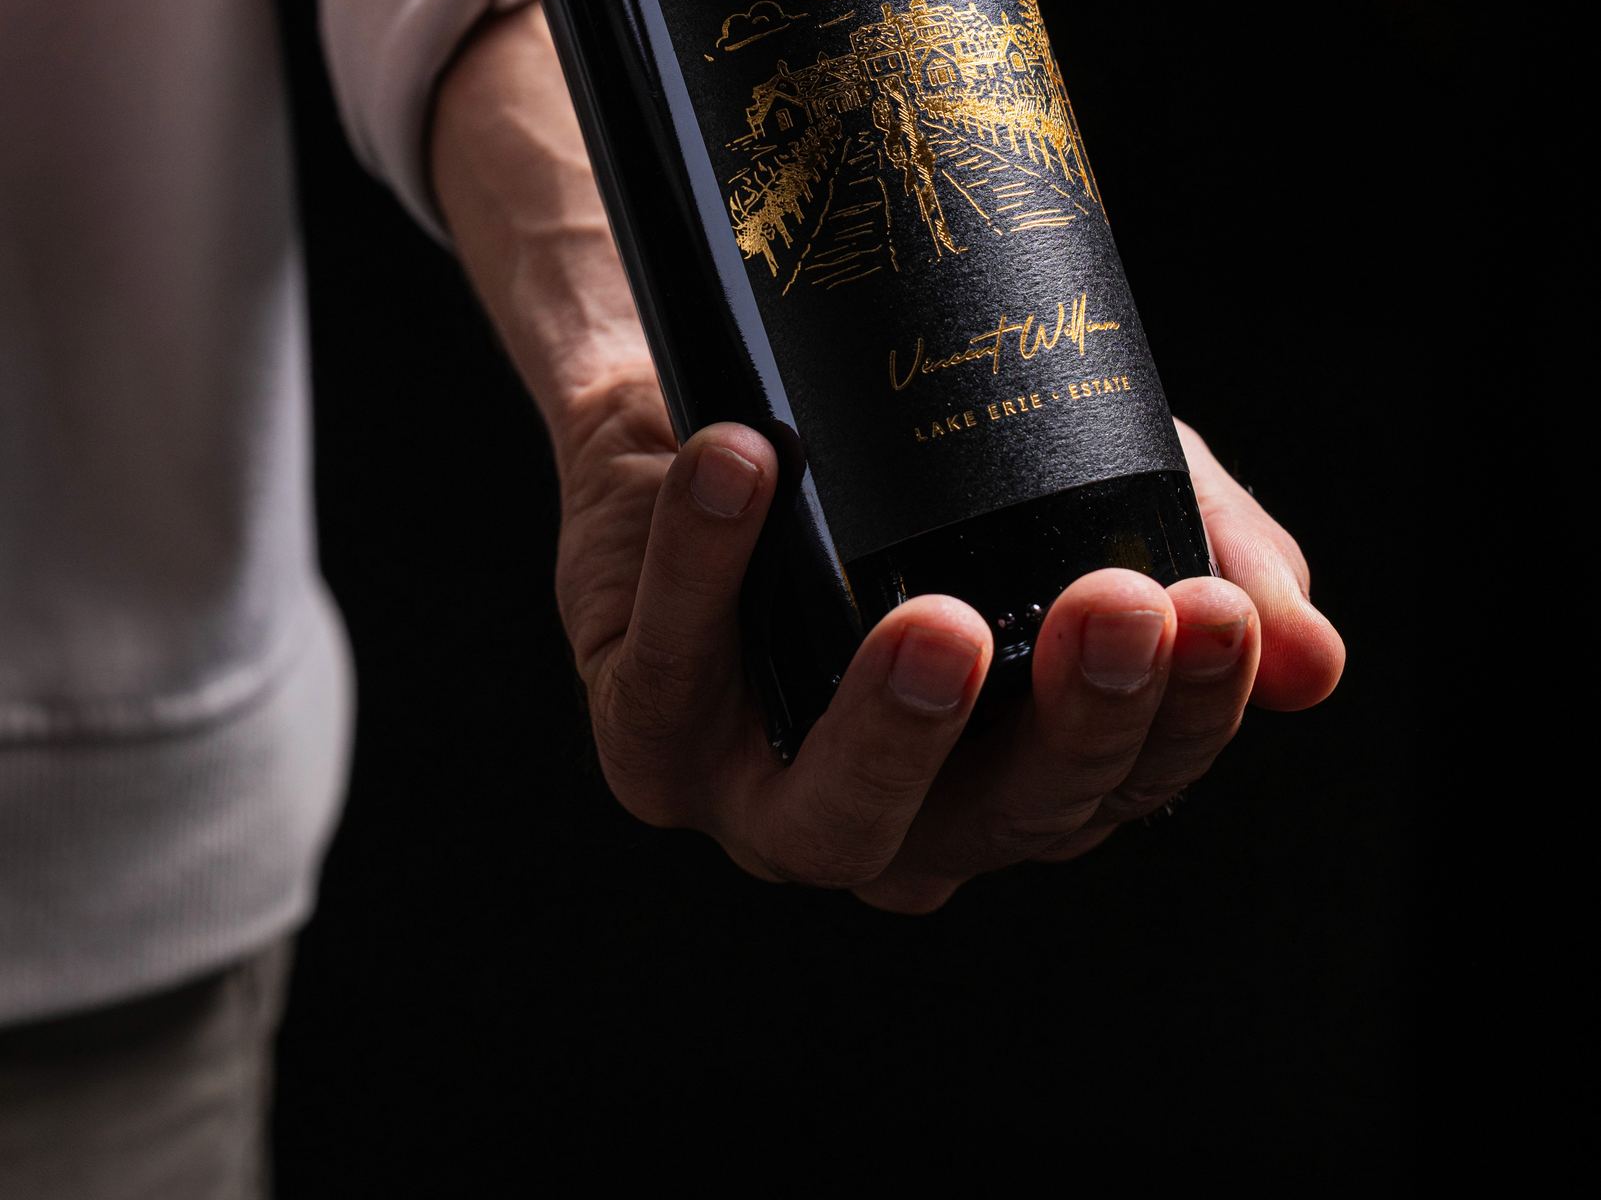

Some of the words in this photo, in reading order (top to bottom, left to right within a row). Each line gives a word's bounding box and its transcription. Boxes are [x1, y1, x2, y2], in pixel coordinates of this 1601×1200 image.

[888, 313, 1023, 391] Vincent
[1020, 292, 1121, 359] William
[914, 410, 977, 443] LAKE
[987, 393, 1044, 421] ERIE
[1067, 374, 1131, 400] ESTATE
